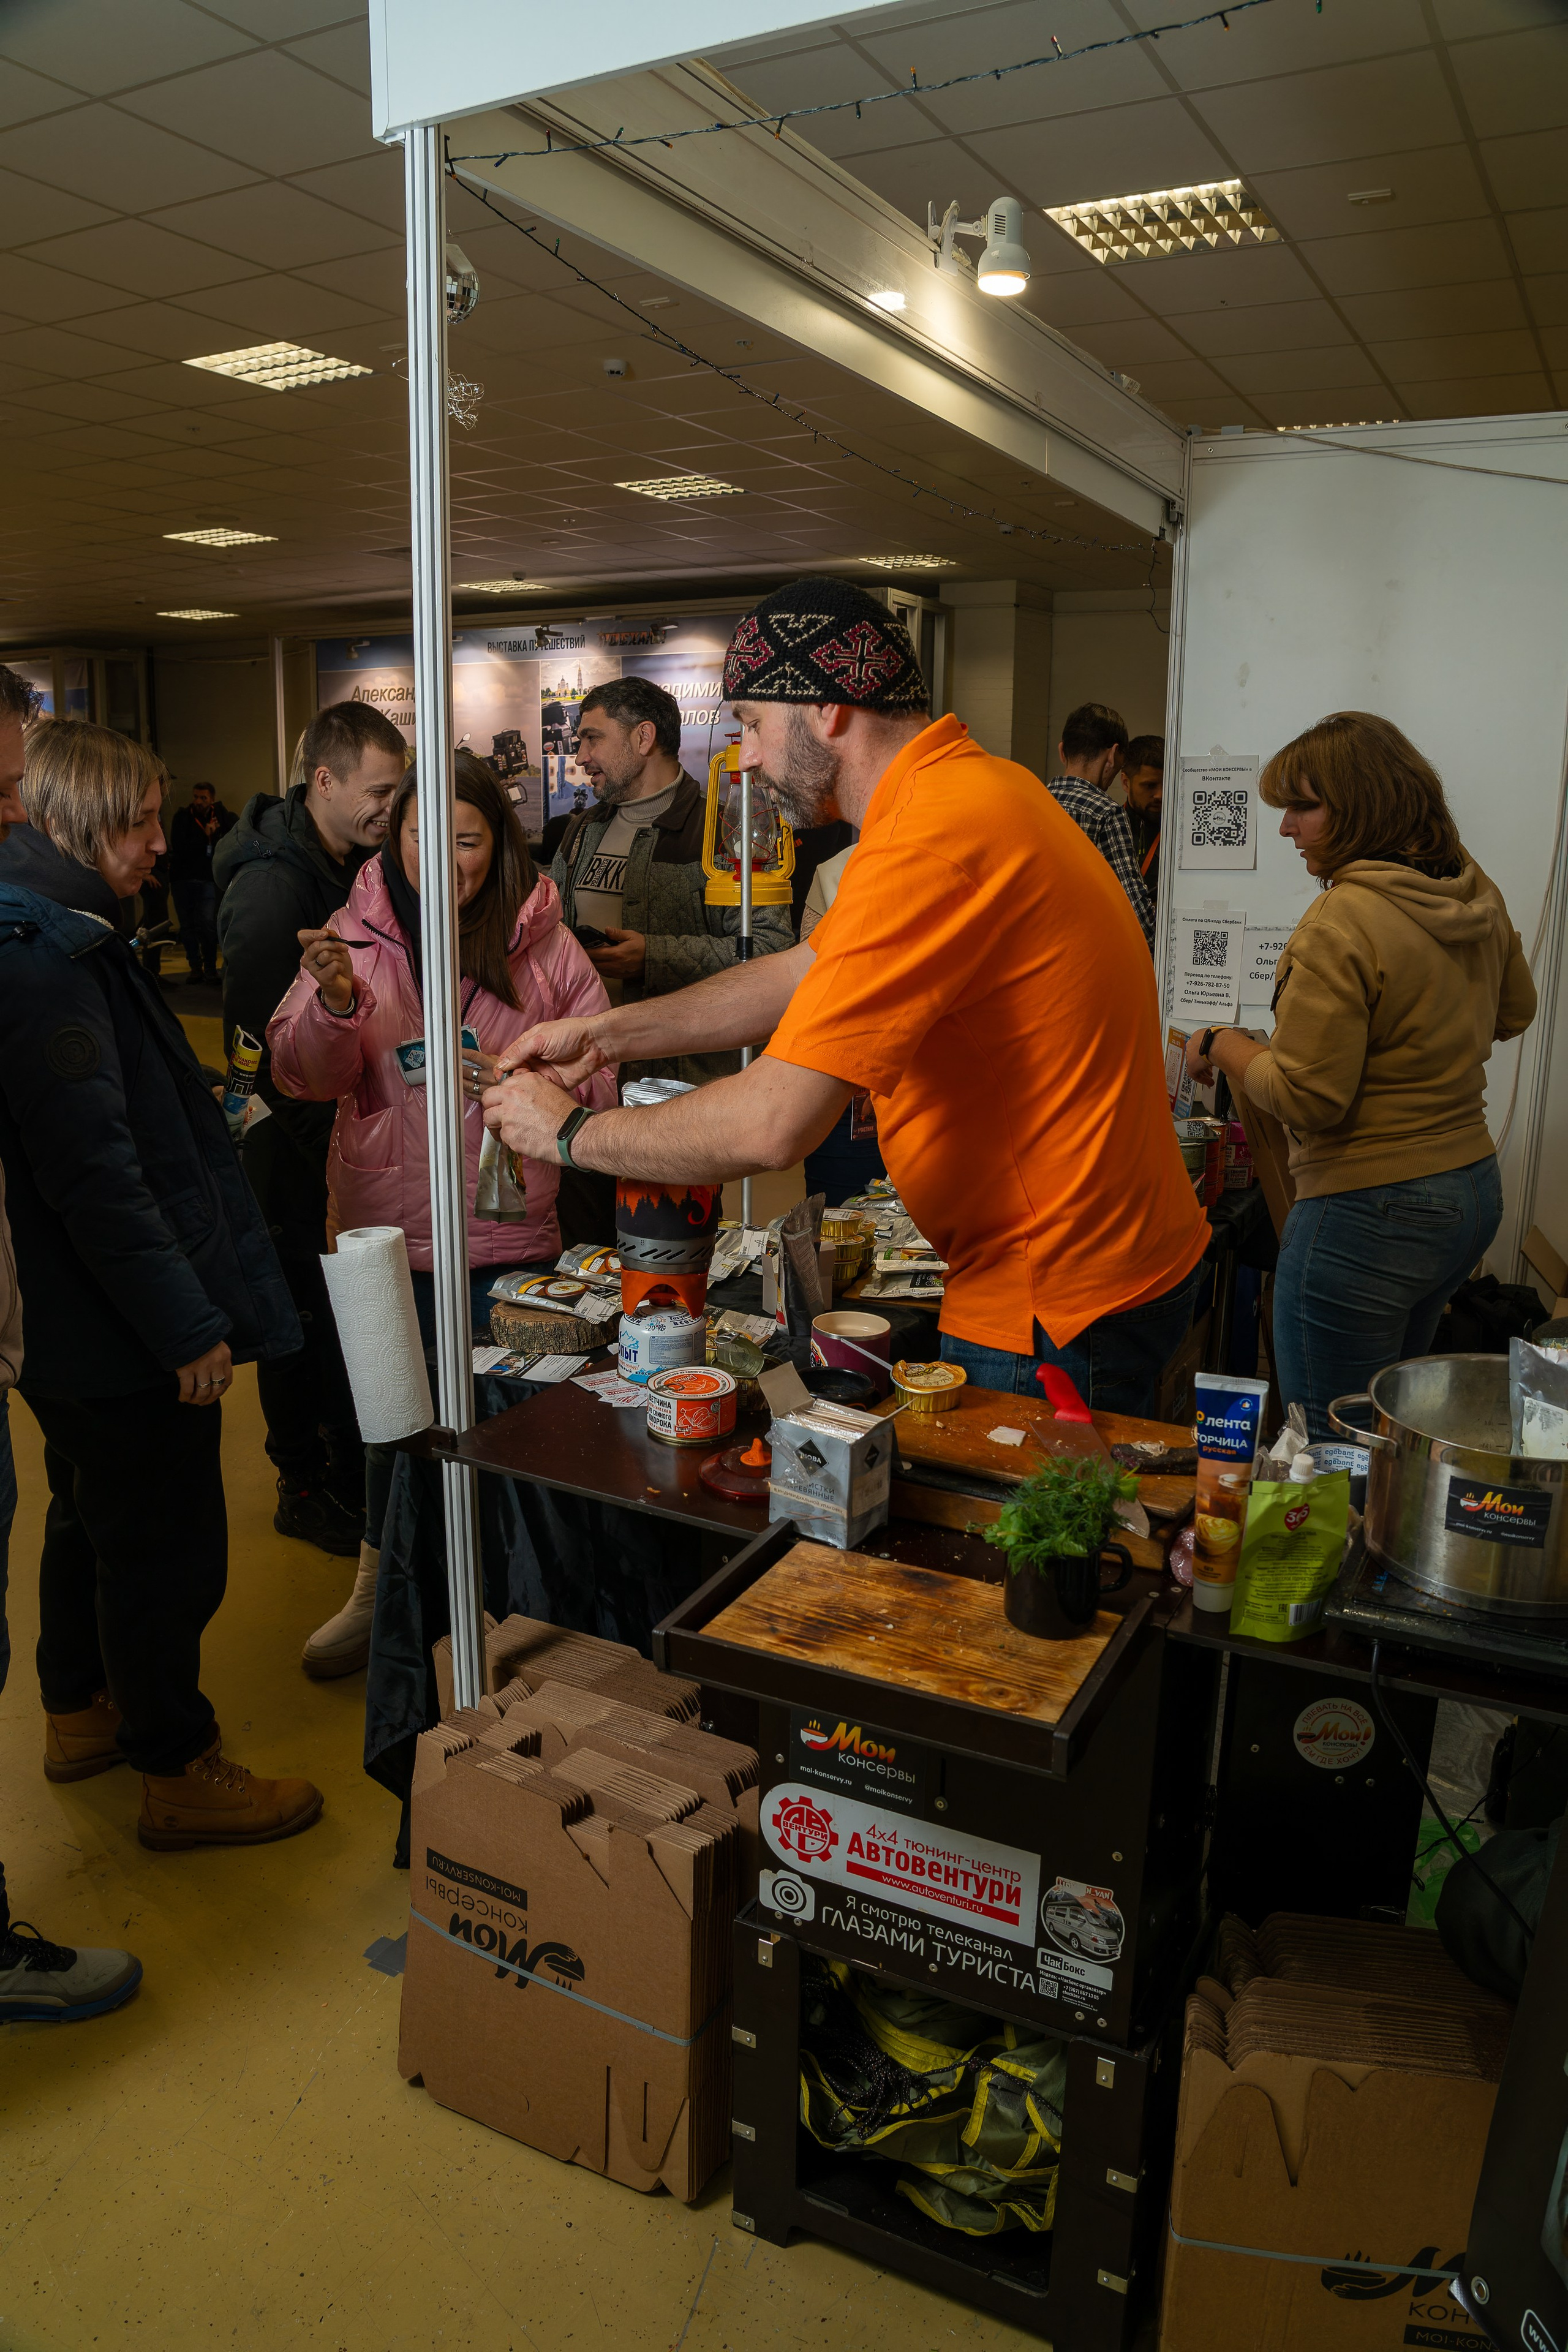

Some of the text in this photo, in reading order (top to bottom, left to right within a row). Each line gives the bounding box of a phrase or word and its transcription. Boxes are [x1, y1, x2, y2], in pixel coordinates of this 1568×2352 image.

[488, 635, 586, 653] ВЫСТАВКА ПУЕШЕСТВИЙ
[351, 685, 415, 703] Алексан
[658, 682, 722, 701] адими
[1250, 971, 1275, 981] Сбер/
[649, 1393, 672, 1409] ВЕТЧИНА
[649, 1414, 672, 1430] ОКОРОКА
[653, 1409, 672, 1421] СВИНОГО
[1205, 1417, 1251, 1430] лента
[1202, 1446, 1237, 1455] русская
[1325, 1448, 1355, 1457] egebant
[1324, 1458, 1354, 1467] egebant
[1357, 1463, 1370, 1471] ege
[788, 1483, 834, 1501] РЕВЯННЫЕ
[809, 1483, 835, 1494] ИСТКИ
[1479, 1491, 1525, 1516] Мои
[1483, 1511, 1536, 1526] консервы
[1302, 1703, 1338, 1724] ПЛЕВАТЬ
[1340, 1703, 1352, 1713] НА
[828, 1721, 896, 1764] Мои
[1303, 1746, 1363, 1765] ЕМ ГДЕ ХОЧУ!
[838, 1752, 916, 1784] консервы
[800, 1765, 913, 1804] moi-konservy.ru @moikonservy
[783, 1820, 828, 1840] ВЕНТУРИ
[904, 1838, 1022, 1884] тюнинг-центр
[432, 1855, 521, 1902] MOI-KONSERVY.RU
[881, 1875, 984, 1913] www.autoventuri.ru
[426, 1875, 527, 1934] консервы
[846, 1895, 1013, 1962] Я смотрю телеканал
[822, 1906, 1036, 1994] ГЛАЗАМИ ТУРИСТА
[1039, 1970, 1058, 1980] Модель:
